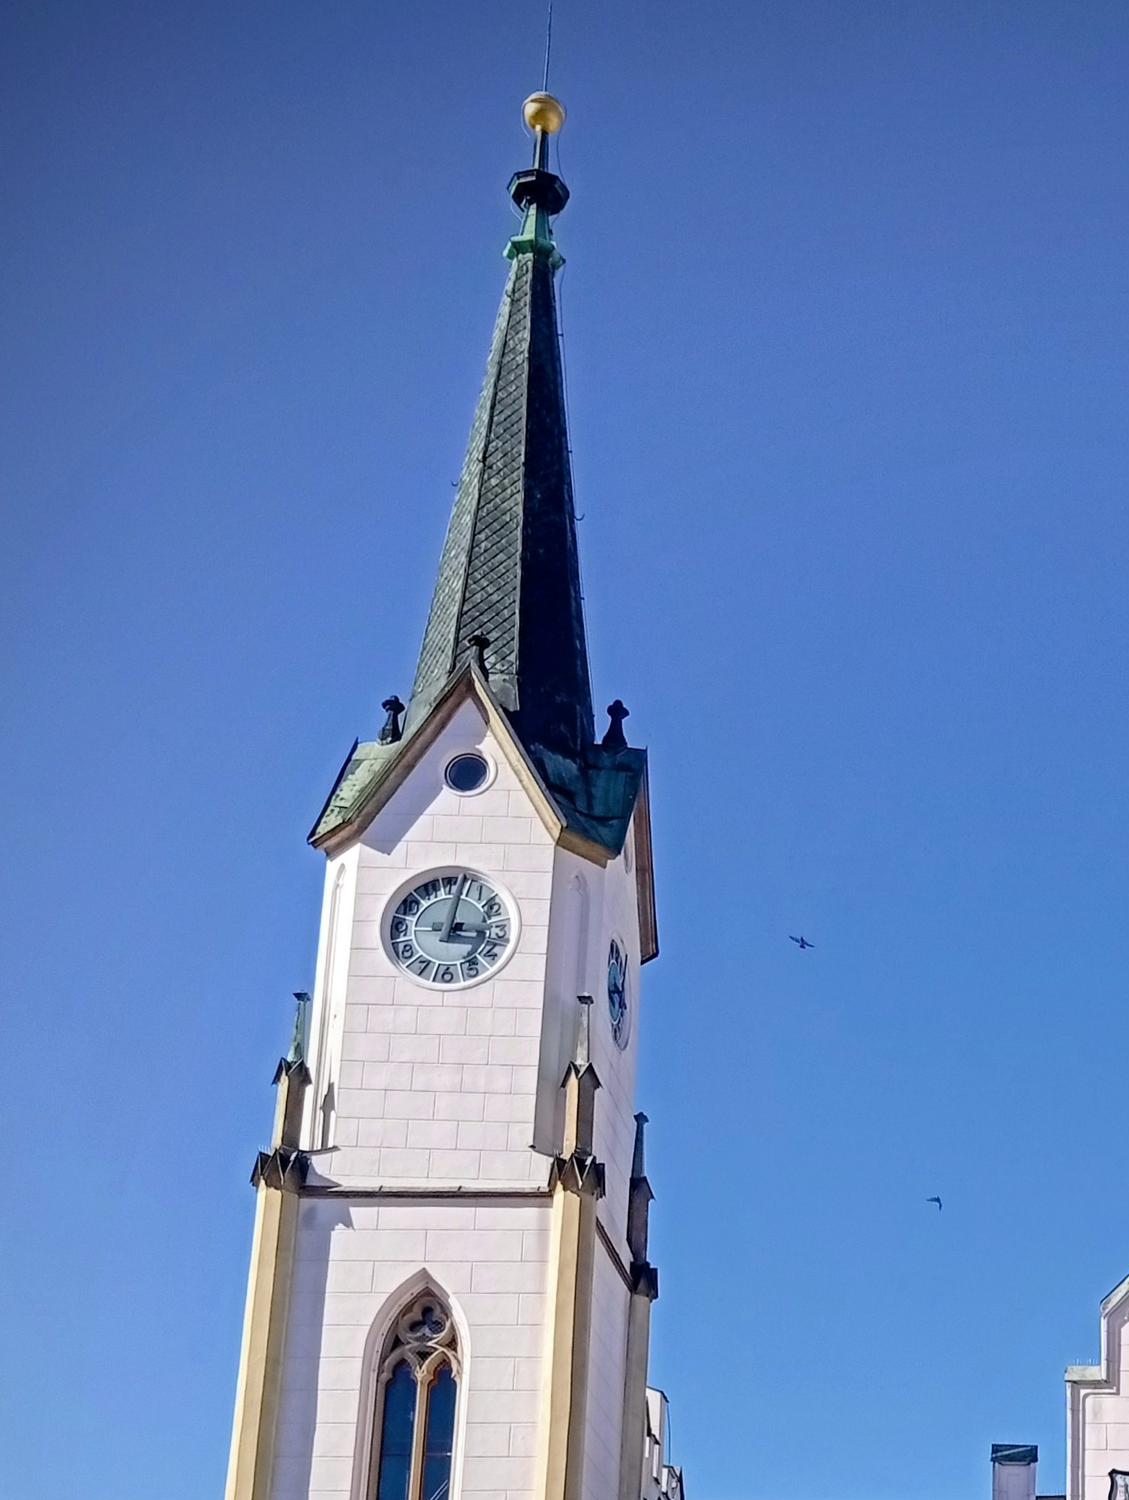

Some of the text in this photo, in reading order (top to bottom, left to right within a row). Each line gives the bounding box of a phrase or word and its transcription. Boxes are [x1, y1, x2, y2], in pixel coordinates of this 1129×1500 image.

[489, 902, 502, 918] 2
[395, 920, 408, 937] 9
[495, 924, 507, 939] 3
[401, 943, 413, 960] 8
[483, 941, 498, 961] 4
[418, 959, 432, 976] 7
[441, 966, 454, 984] 6
[466, 961, 479, 978] 5
